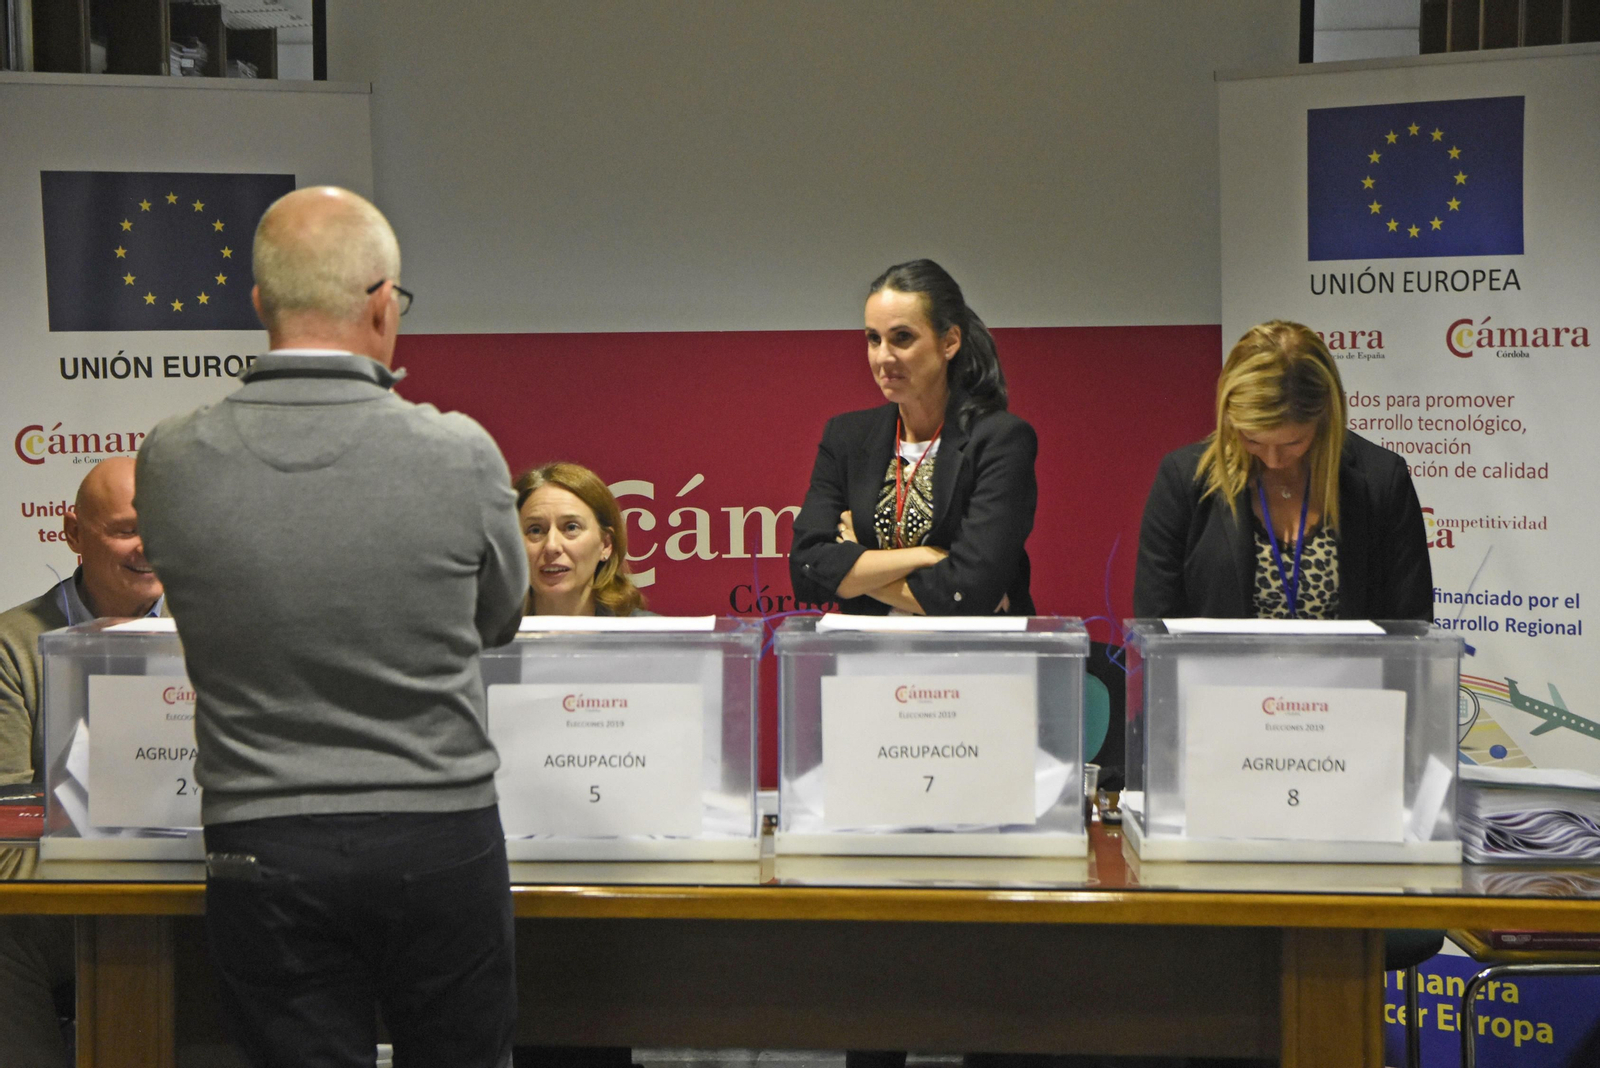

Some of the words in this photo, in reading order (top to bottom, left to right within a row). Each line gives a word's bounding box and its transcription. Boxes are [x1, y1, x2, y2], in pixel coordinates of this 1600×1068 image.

[1310, 266, 1395, 295] UNIÓN
[1403, 268, 1522, 293] EUROPEA
[1496, 350, 1530, 359] Córdoba
[60, 350, 152, 380] UNIÓN
[1386, 395, 1421, 411] para
[1425, 394, 1516, 411] promover
[1418, 414, 1527, 436] tecnológico,
[1454, 461, 1477, 478] de
[1482, 461, 1549, 479] calidad
[1528, 594, 1559, 611] por
[1564, 592, 1580, 609] el
[1505, 617, 1582, 637] Regional
[938, 710, 957, 719] 2019
[1305, 723, 1325, 732] 2019
[877, 741, 979, 759] AGRUPACIÓN
[543, 751, 646, 768] AGRUPACIÓN
[1241, 756, 1346, 772] AGRUPACIÓN
[176, 778, 187, 796] 2
[923, 775, 935, 793] 7
[589, 785, 601, 803] 5
[1287, 788, 1300, 807] 8
